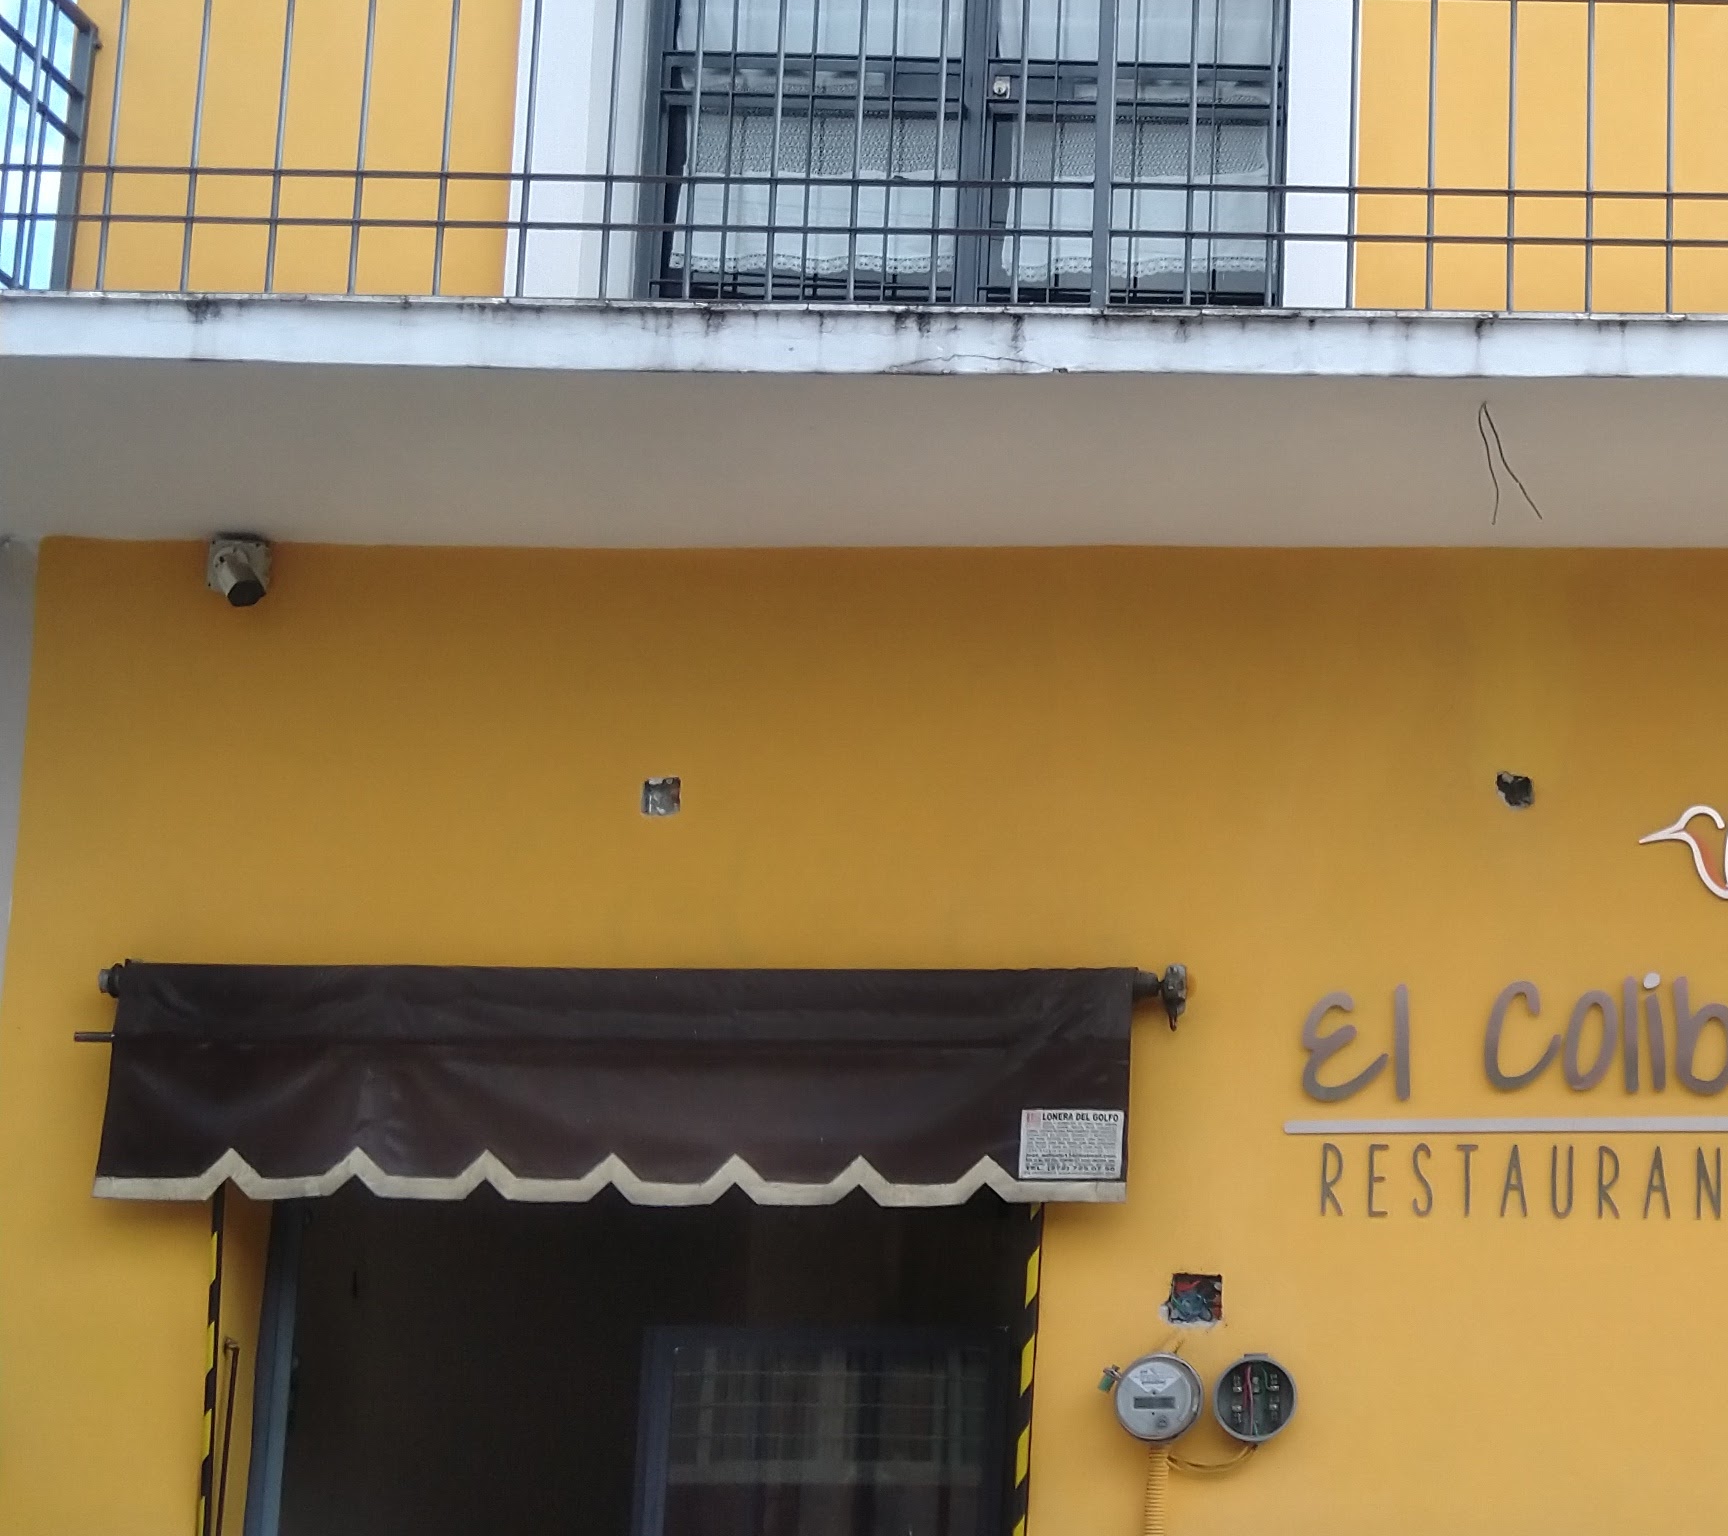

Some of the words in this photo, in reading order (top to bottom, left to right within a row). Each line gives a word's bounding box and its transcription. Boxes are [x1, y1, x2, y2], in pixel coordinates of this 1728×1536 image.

[1301, 984, 1410, 1102] El
[1042, 1112, 1073, 1121] LONERA
[1076, 1113, 1090, 1121] DEL
[1093, 1113, 1119, 1122] GOLFO
